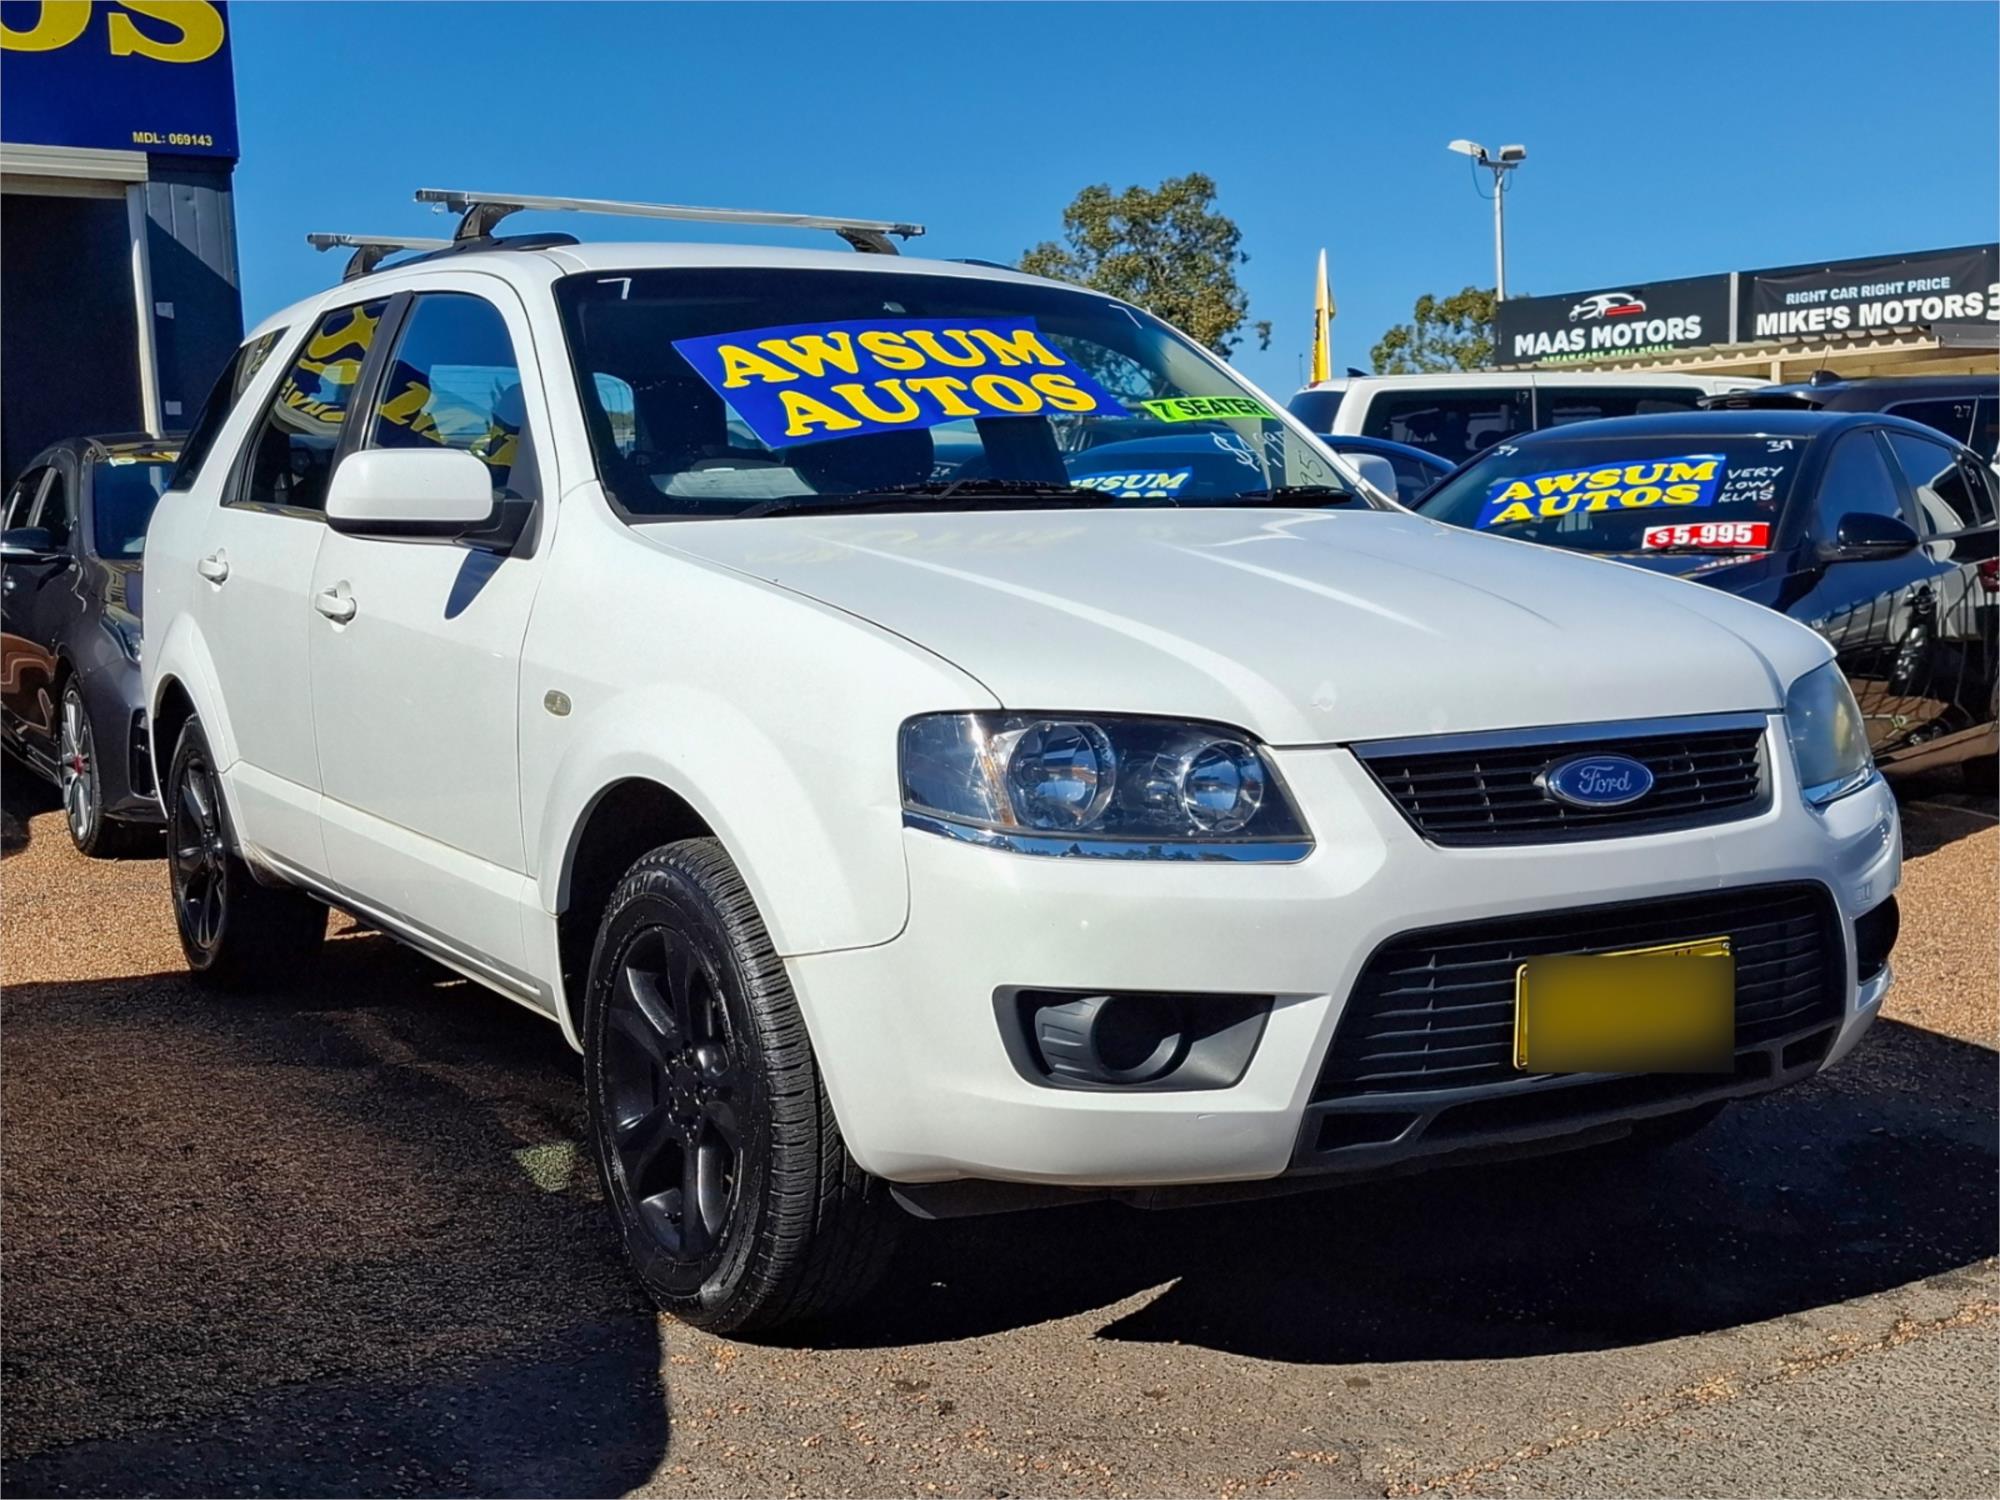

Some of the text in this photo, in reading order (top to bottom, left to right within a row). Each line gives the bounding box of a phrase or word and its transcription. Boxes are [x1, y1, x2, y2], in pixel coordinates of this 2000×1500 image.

[132, 131, 213, 146] MDL: 069143
[1786, 276, 1951, 305] RIGHT CAR RIGHT PRICE
[1756, 292, 1984, 336] MIKE'S MOTORS
[1514, 315, 1702, 357] MAAS MOTORS
[718, 328, 1066, 388] AWSUM
[779, 373, 1097, 436] AUTOS
[1151, 399, 1268, 419] 7 SEATER
[1491, 461, 1719, 504] AWSUM
[1724, 479, 1771, 490] LOW
[1727, 466, 1784, 480] VERY
[1489, 484, 1702, 524] AUTOS
[1718, 489, 1774, 503] KLMS
[1655, 523, 1753, 545] $5,995
[1578, 765, 1632, 794] Ford
